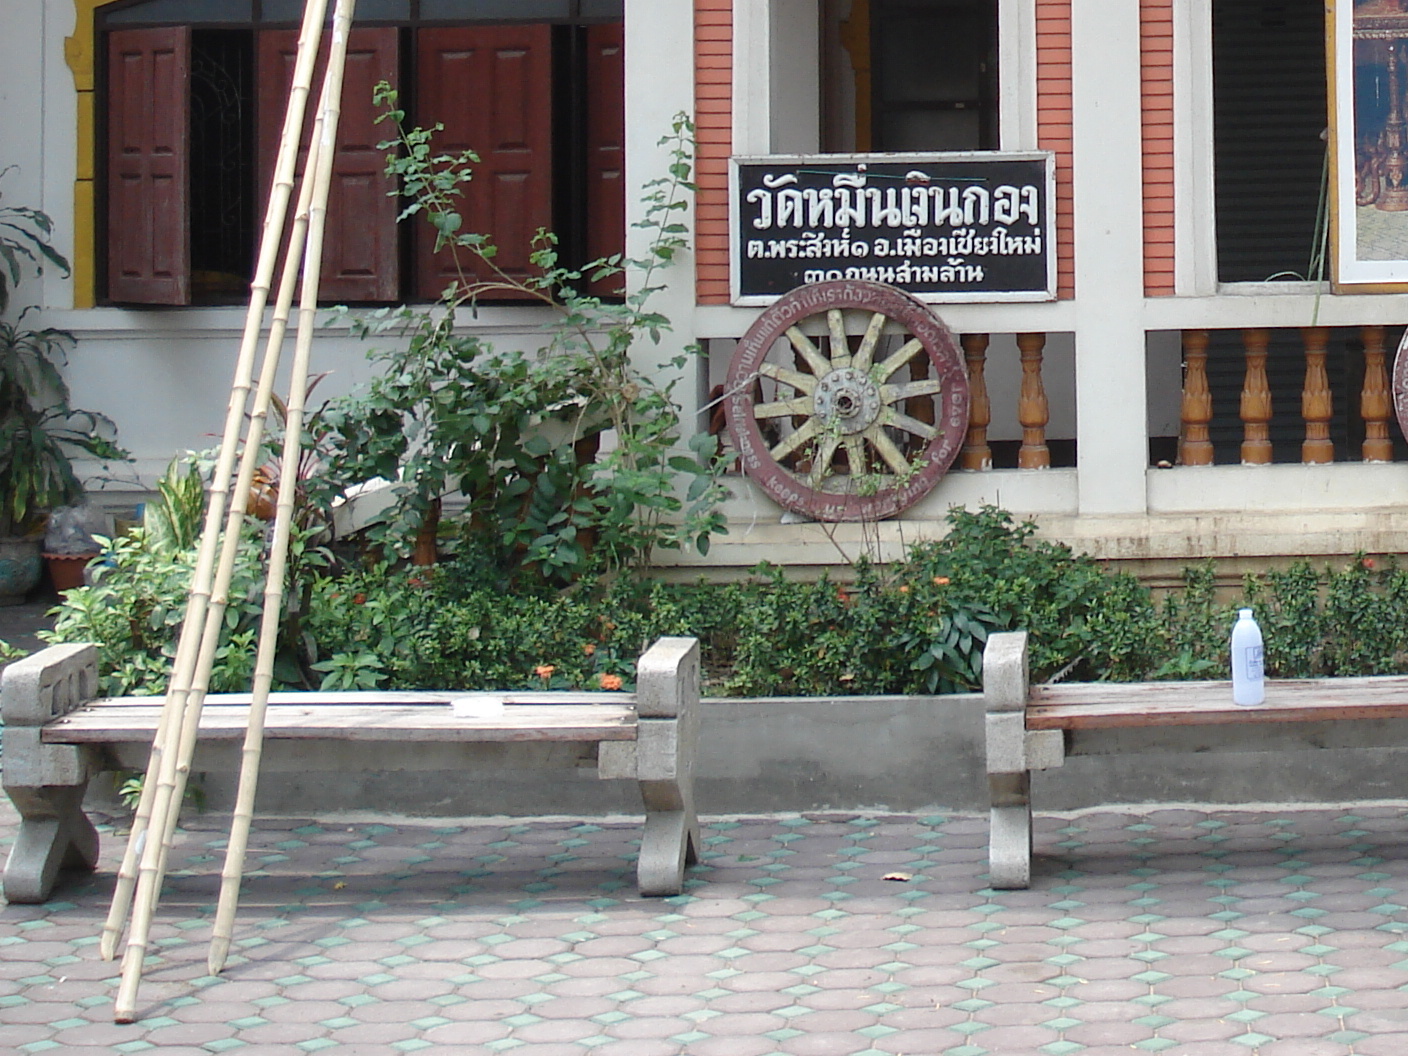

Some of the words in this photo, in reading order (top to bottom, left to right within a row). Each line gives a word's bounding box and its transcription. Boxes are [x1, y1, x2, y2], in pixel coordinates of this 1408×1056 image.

[746, 163, 1039, 229] วัดหมื่นเงินกอง
[930, 439, 953, 465] for
